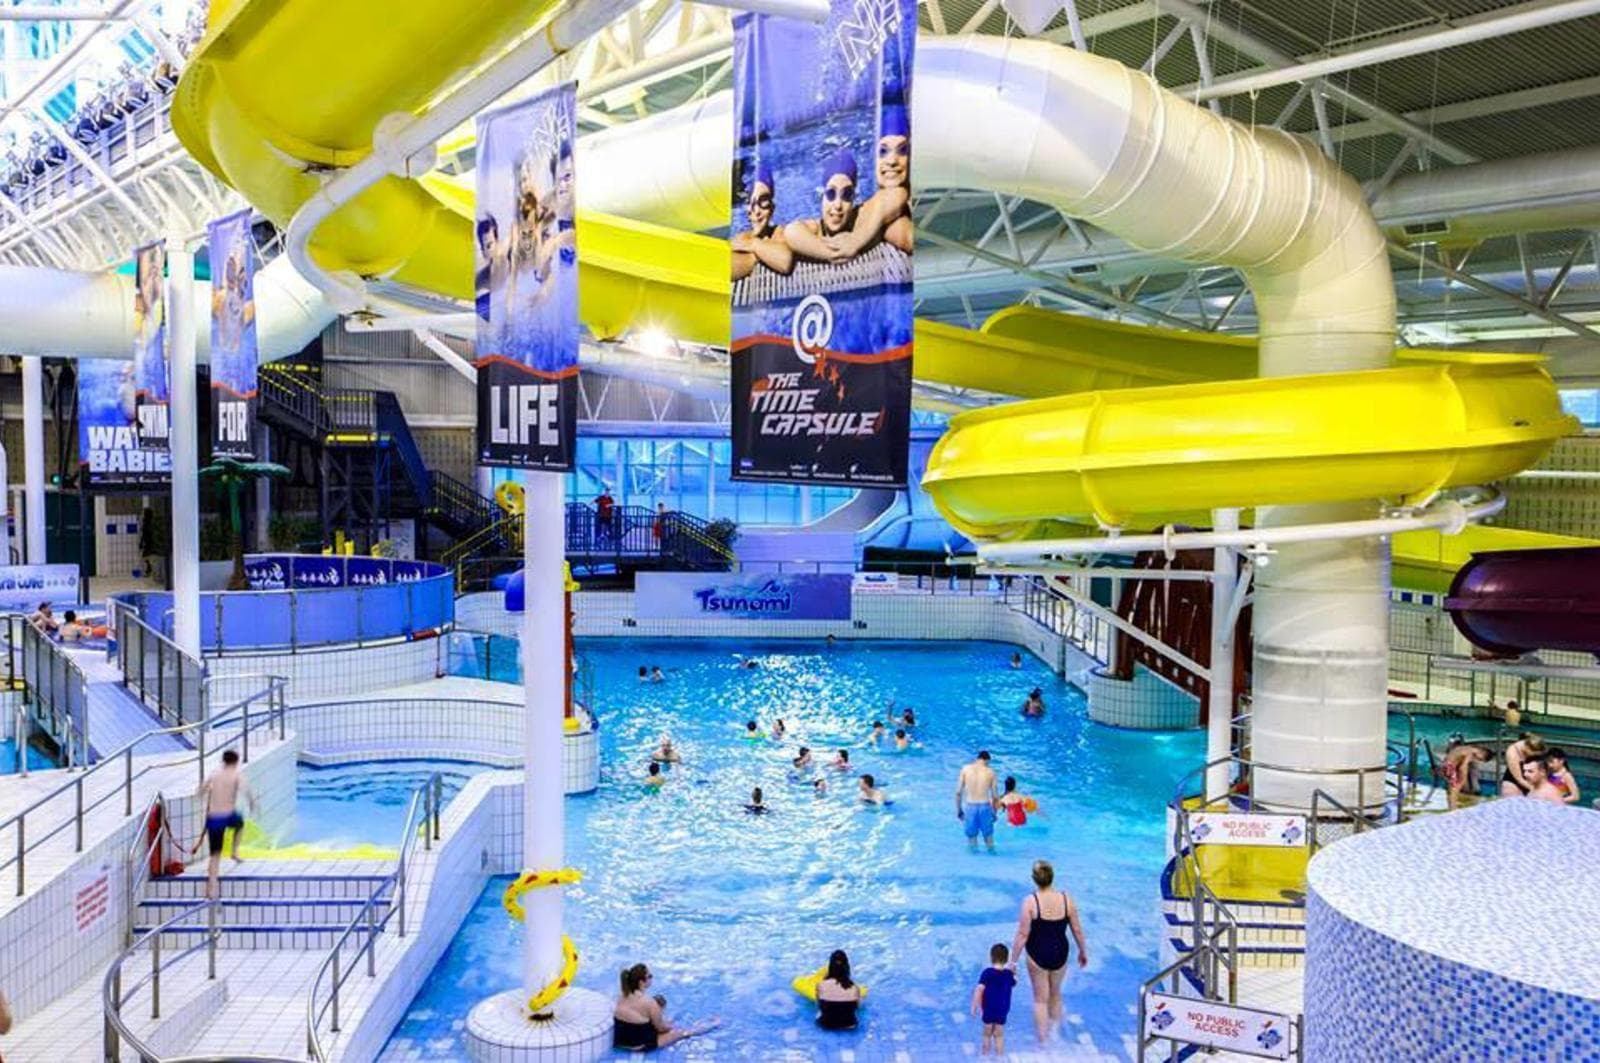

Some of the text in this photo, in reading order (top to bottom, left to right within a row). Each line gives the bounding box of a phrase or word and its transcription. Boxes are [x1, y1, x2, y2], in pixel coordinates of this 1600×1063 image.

[793, 294, 833, 364] @
[767, 373, 803, 389] THE
[751, 389, 820, 413] TIME
[218, 401, 247, 441] FOR
[491, 384, 559, 446] LIFE
[760, 412, 880, 436] CAPSULE
[88, 450, 173, 473] BABIE
[695, 588, 792, 612] Tsunami
[1221, 821, 1272, 831] NO PUBLIC
[1228, 830, 1266, 838] ACCESS
[1187, 1011, 1246, 1030] NO PUBLIC
[1194, 1021, 1240, 1038] ACCESS
